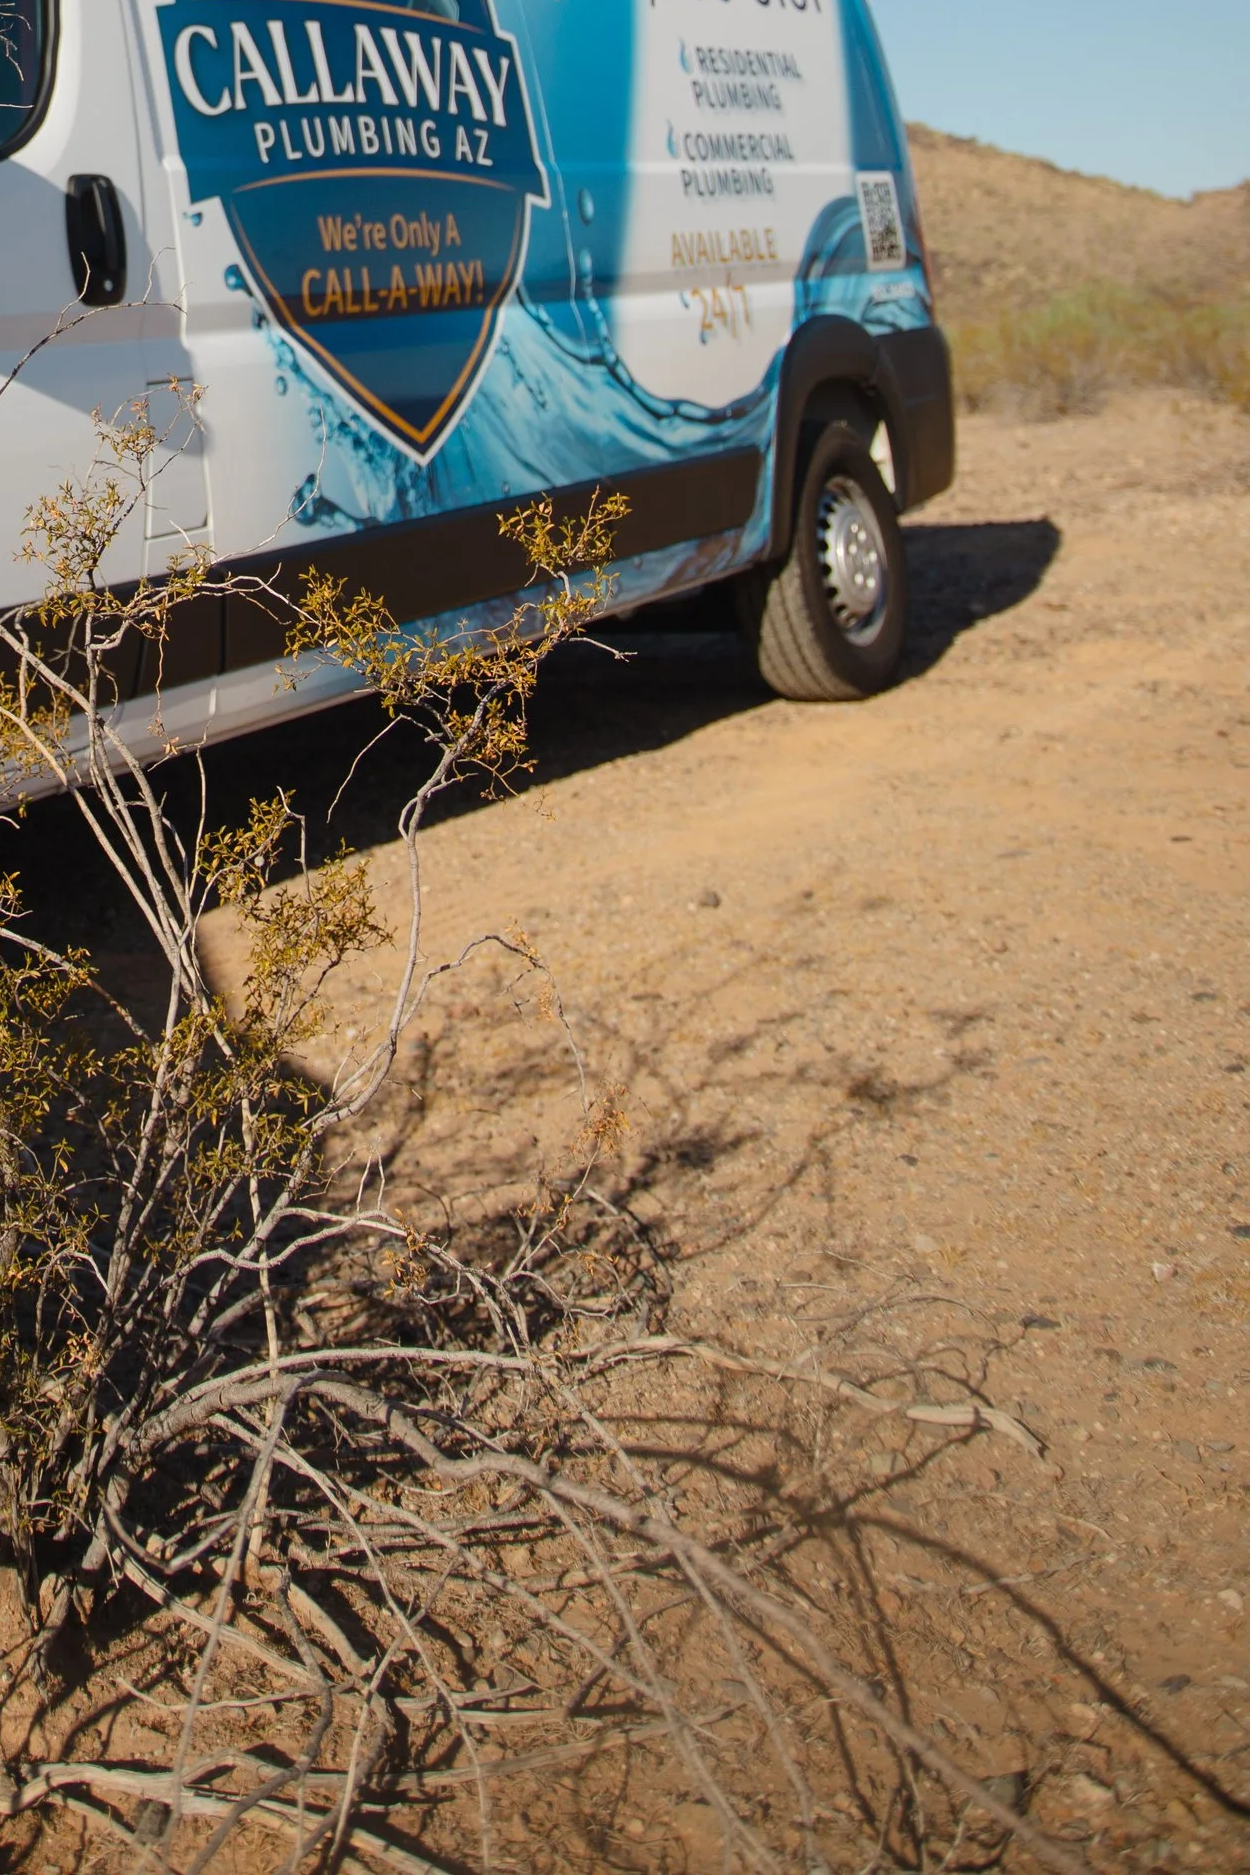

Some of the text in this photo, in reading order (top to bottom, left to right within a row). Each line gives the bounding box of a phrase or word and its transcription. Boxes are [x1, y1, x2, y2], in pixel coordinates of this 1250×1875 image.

[173, 19, 510, 128] CALLAWAY
[694, 45, 803, 80] RESIDENTIAL
[691, 79, 783, 111] PLUMBING
[253, 115, 494, 167] PLUMBING AZ
[683, 132, 795, 162] COMMERCIAL
[680, 167, 775, 197] PLUMBING
[316, 210, 462, 257] We're Only A
[671, 227, 778, 267] AVAILABLE
[301, 258, 484, 318] CALL-A-WAY!
[690, 267, 753, 341] 24/7
